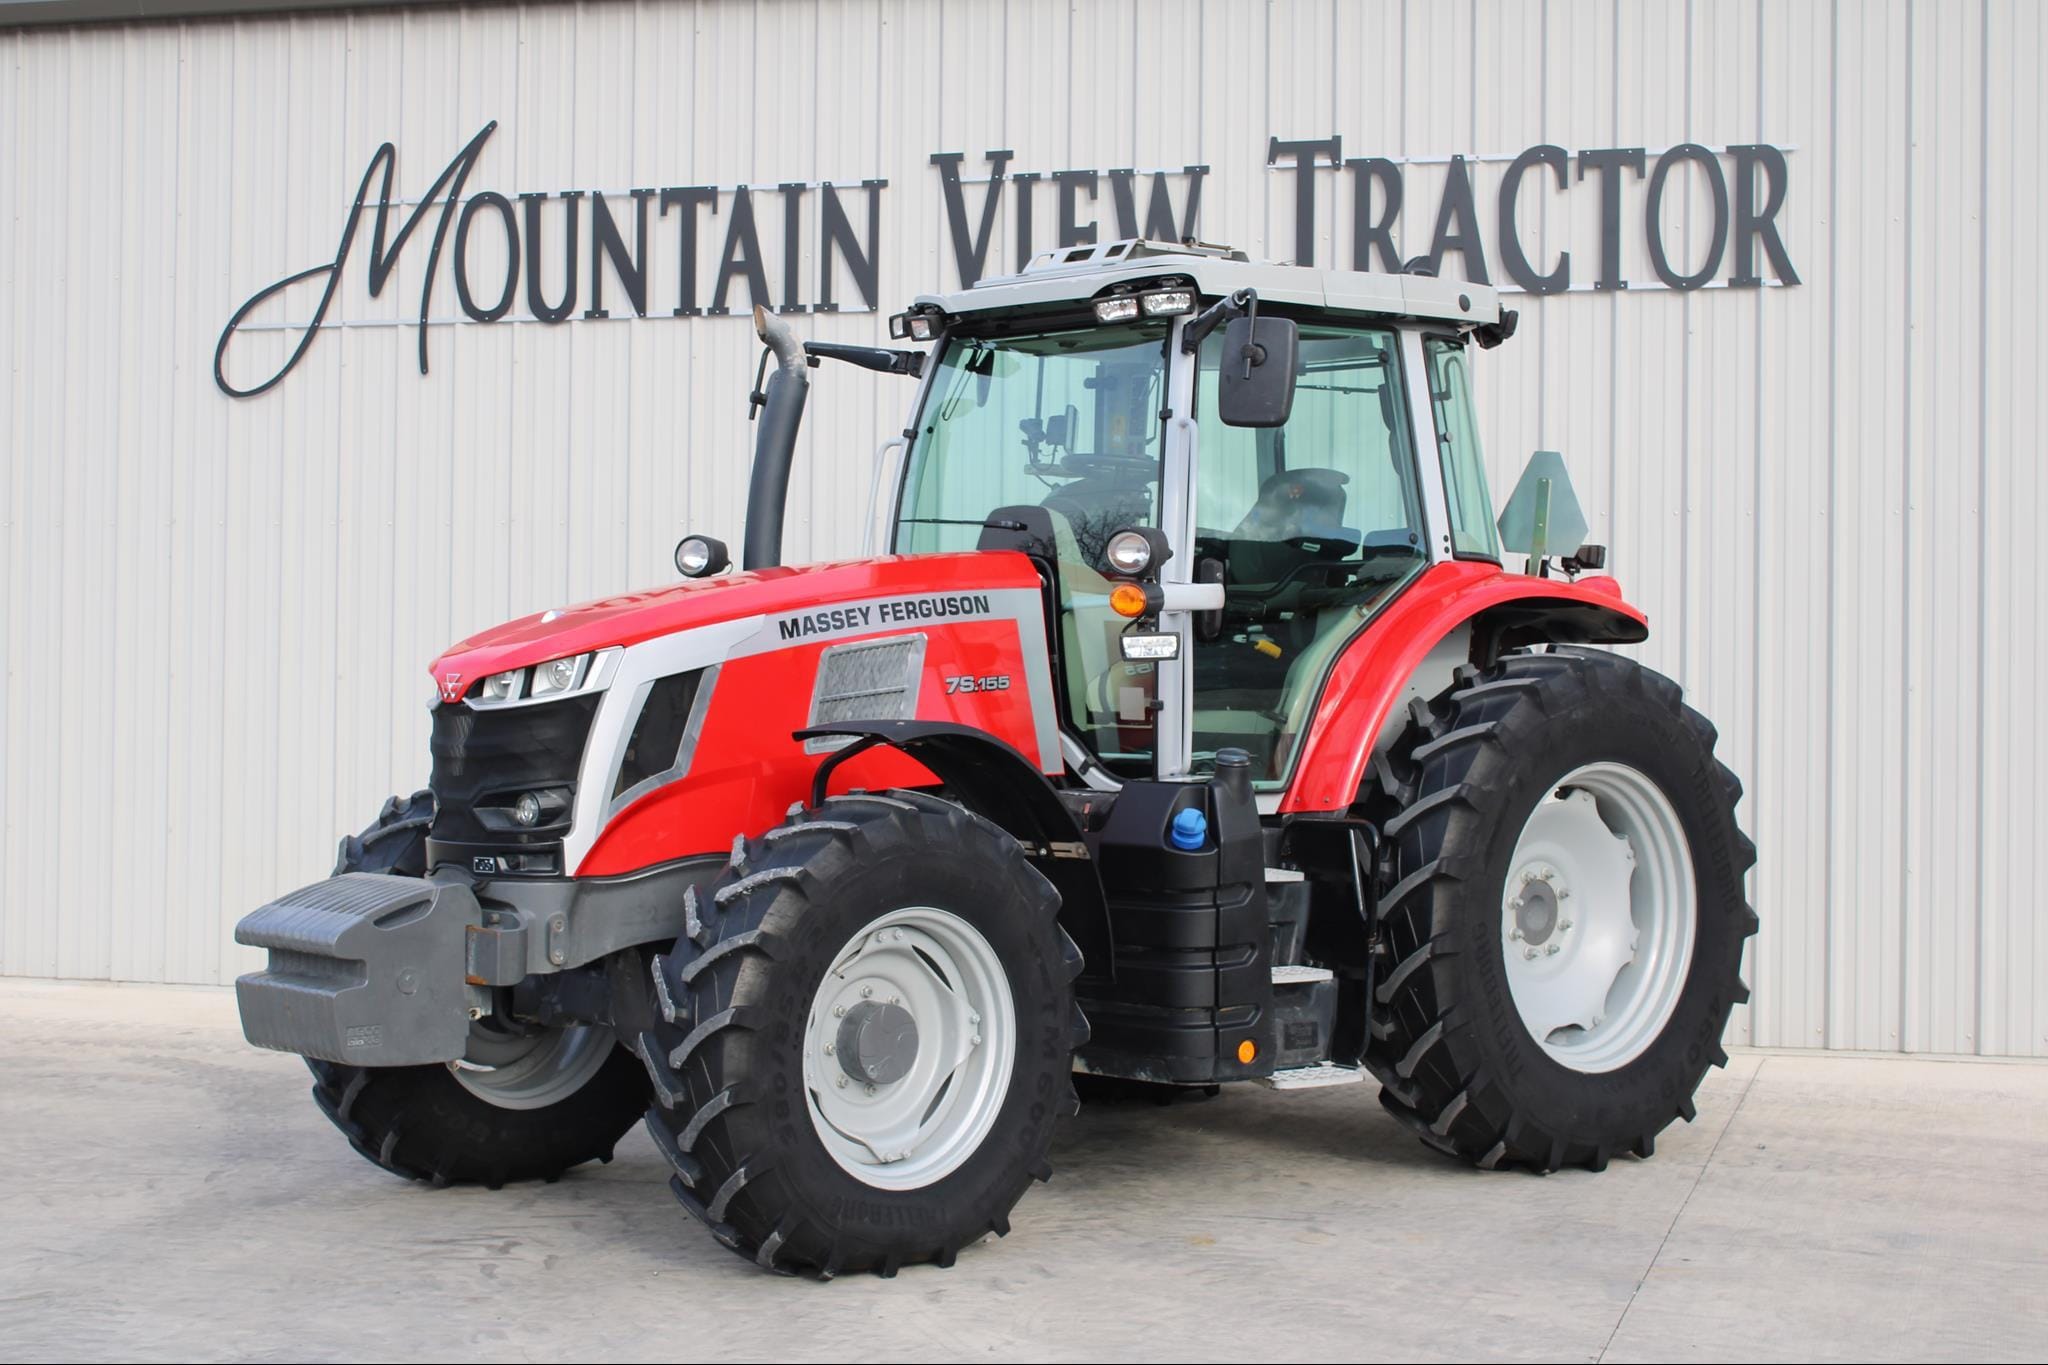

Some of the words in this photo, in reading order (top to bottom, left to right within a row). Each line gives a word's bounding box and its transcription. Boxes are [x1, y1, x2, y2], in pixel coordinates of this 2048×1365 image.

[214, 119, 889, 399] MOUNTAIN
[929, 149, 1210, 290] VIEW
[1267, 134, 1803, 295] TRACTOR
[778, 605, 871, 641] MASSEY
[877, 594, 990, 624] FERGUSON
[944, 674, 1011, 695] 7S.155
